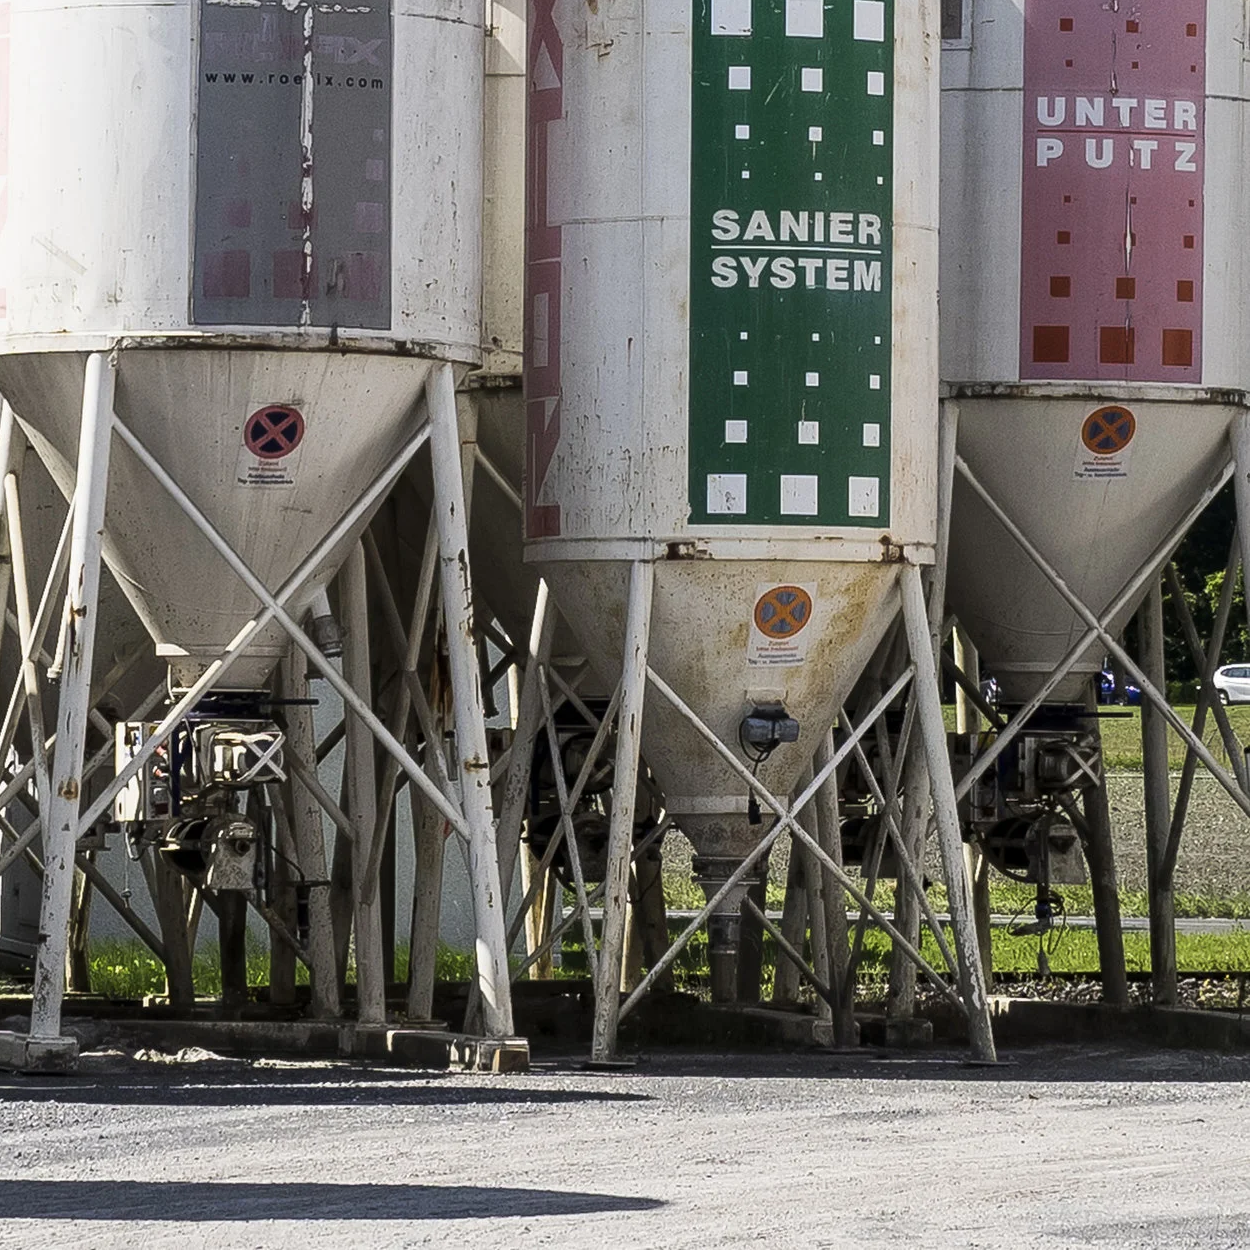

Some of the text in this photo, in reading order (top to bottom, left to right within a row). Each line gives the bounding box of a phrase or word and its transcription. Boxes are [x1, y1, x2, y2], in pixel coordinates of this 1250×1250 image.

[205, 72, 384, 89] www.roeix.com
[1036, 96, 1197, 131] UNTER
[1035, 138, 1197, 172] PUTZ
[710, 209, 882, 245] SANIER
[710, 256, 882, 292] SYSTEM
